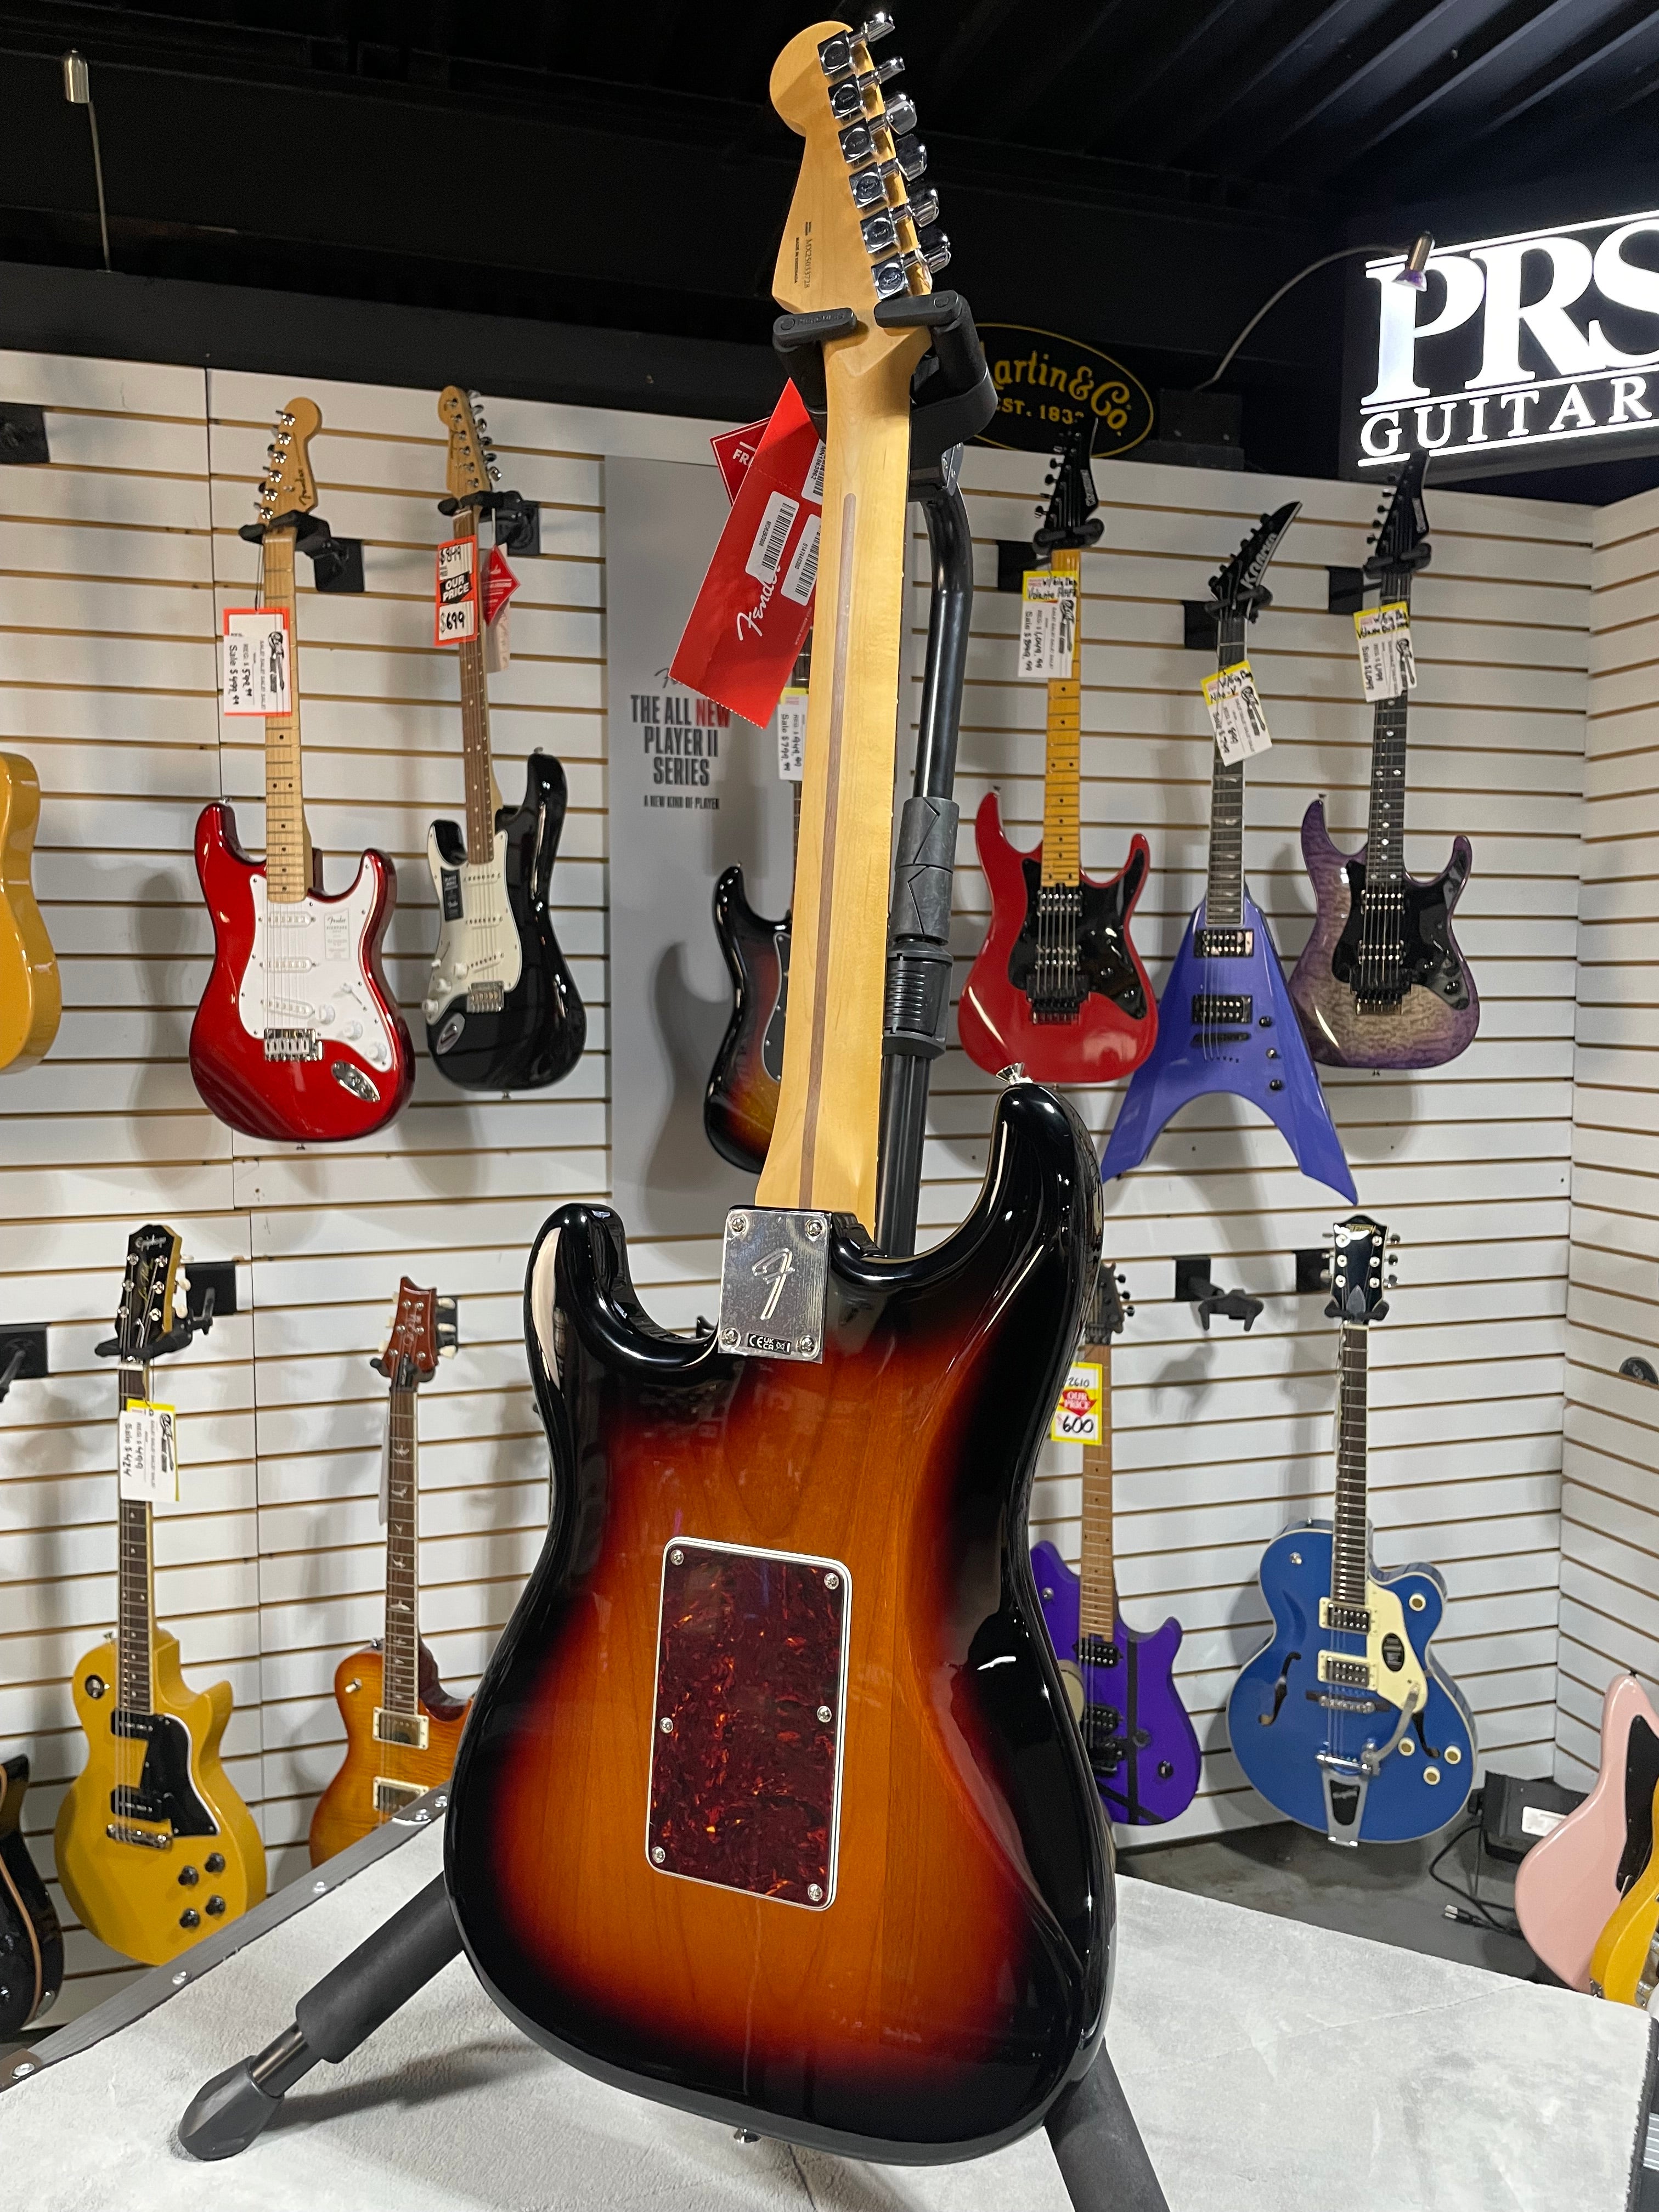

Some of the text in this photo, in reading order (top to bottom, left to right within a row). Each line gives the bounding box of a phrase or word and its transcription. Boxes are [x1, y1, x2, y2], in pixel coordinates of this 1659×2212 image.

[1361, 218, 1659, 406] PRS
[442, 582, 470, 602] PRICE
[445, 575, 465, 590] OUR
[630, 695, 730, 727] THE ALL NEW
[645, 726, 719, 757] PLAYER II
[653, 757, 710, 786] SERIES
[1064, 1399, 1091, 1409] PRICE
[1067, 1391, 1087, 1400] OUR
